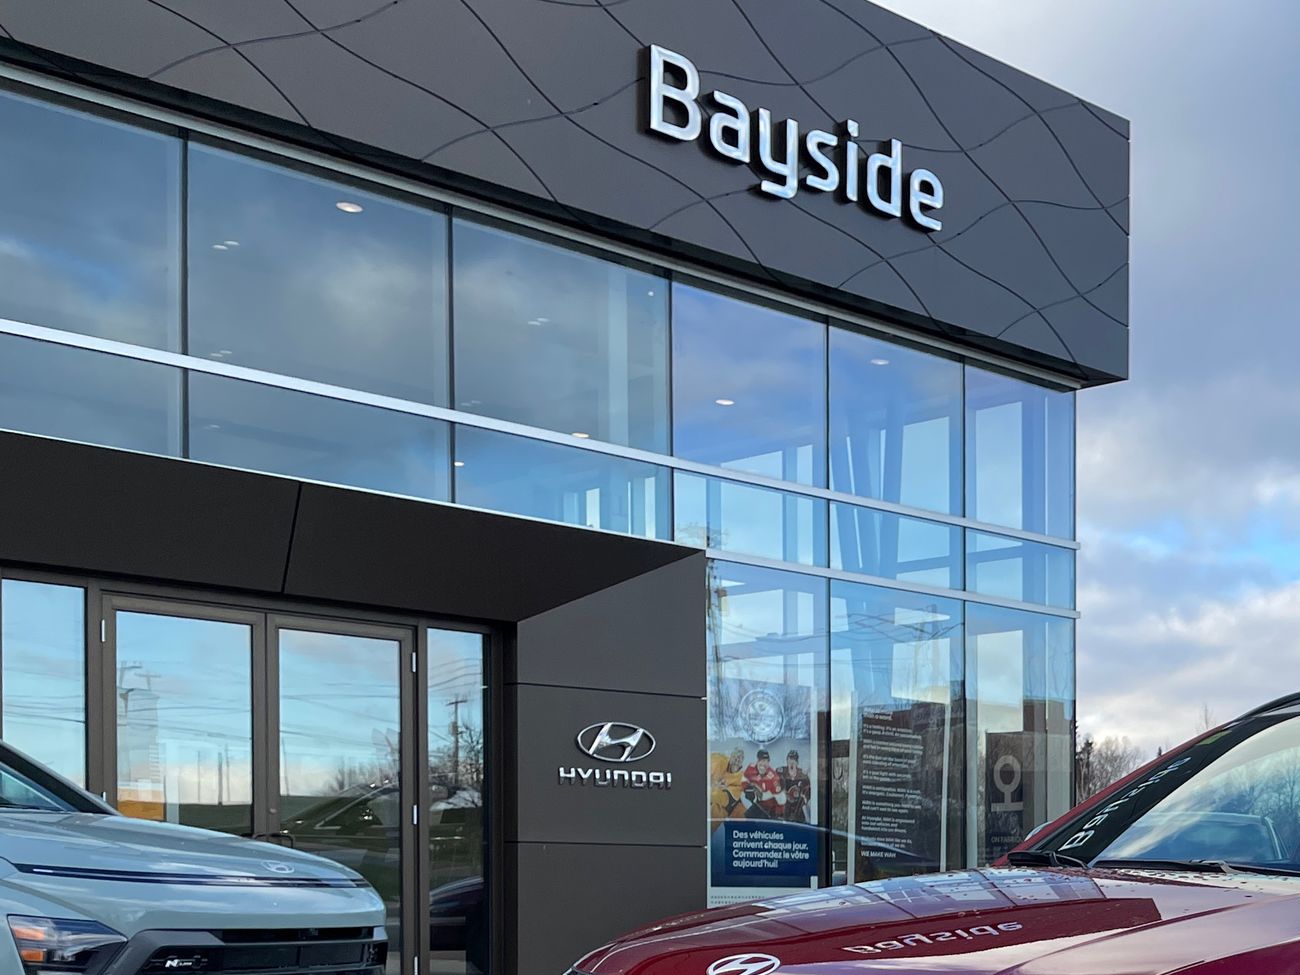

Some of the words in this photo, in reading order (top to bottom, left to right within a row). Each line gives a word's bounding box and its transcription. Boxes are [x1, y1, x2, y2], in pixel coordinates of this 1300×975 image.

[648, 43, 944, 231] Bayside
[558, 766, 672, 783] HYUNDAI
[732, 830, 748, 839] Des
[749, 830, 784, 840] véhicules
[732, 840, 763, 849] arrivent
[764, 840, 792, 851] chaque
[792, 841, 809, 852] jour.
[732, 849, 782, 859] Commandez
[783, 850, 790, 859] le
[790, 851, 810, 860] vôtre
